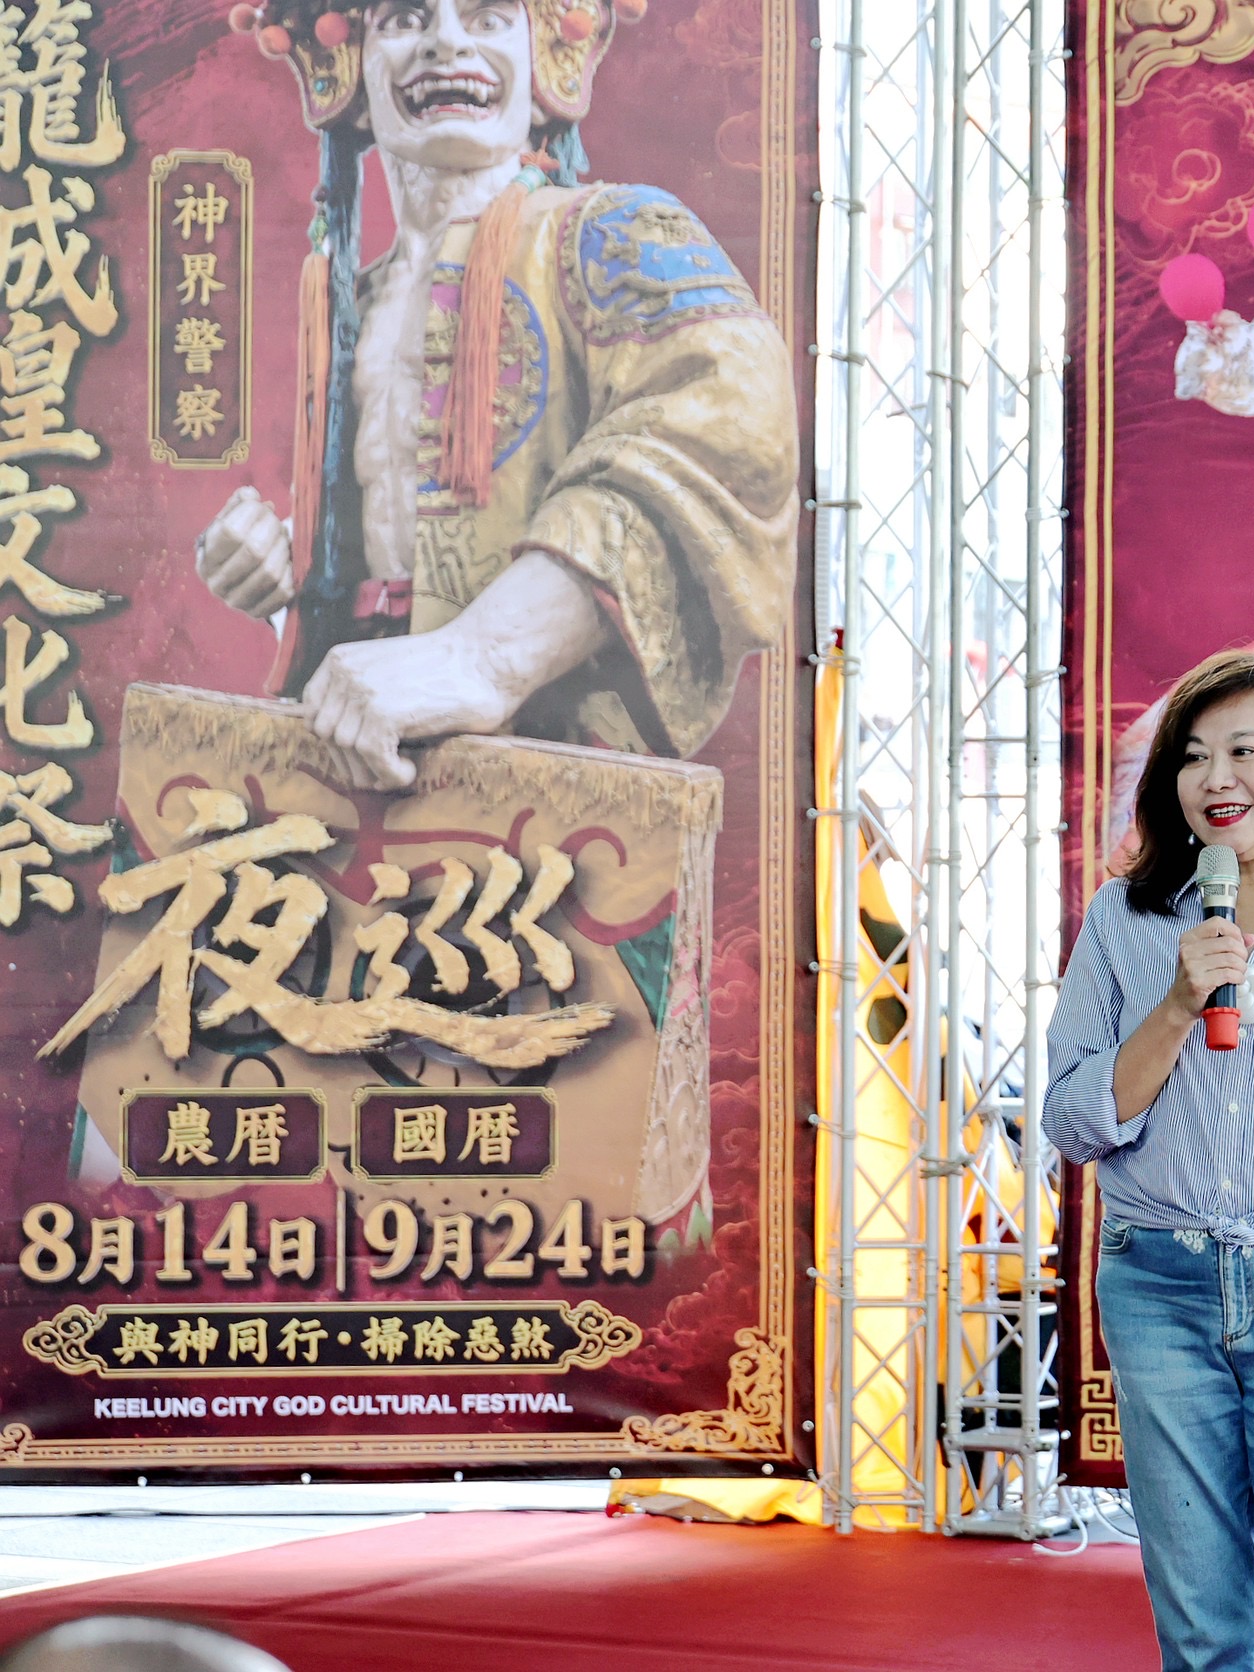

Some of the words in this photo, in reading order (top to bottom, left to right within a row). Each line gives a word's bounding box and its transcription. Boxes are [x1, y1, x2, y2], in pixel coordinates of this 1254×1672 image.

[173, 185, 228, 441] 神界警察
[36, 789, 615, 1067] 夜巡
[94, 1397, 206, 1418] KEELUNG
[211, 1396, 269, 1417] CITY
[273, 1395, 325, 1416] GOD
[330, 1394, 457, 1415] CULTURAL
[461, 1393, 573, 1414] FESTIVAL
